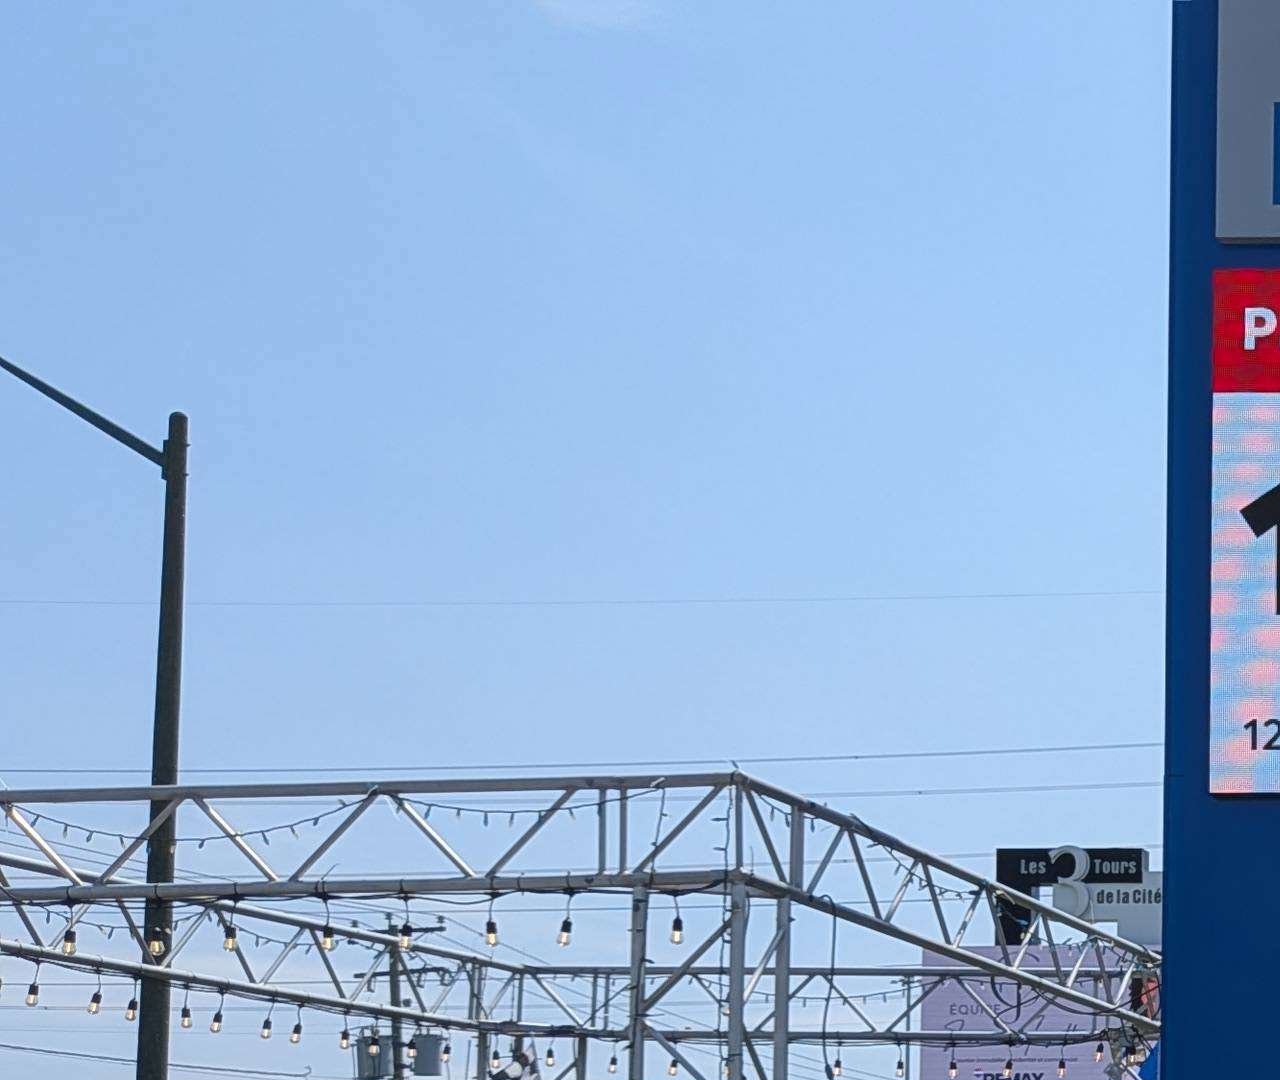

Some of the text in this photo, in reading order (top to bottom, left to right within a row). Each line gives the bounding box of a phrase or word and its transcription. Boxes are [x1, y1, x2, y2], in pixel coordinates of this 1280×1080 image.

[1020, 859, 1047, 874] Les
[1094, 859, 1137, 874] Tours
[1096, 889, 1114, 904] de
[1133, 888, 1162, 905] Cité
[950, 1002, 1001, 1015] ÉQUIE
